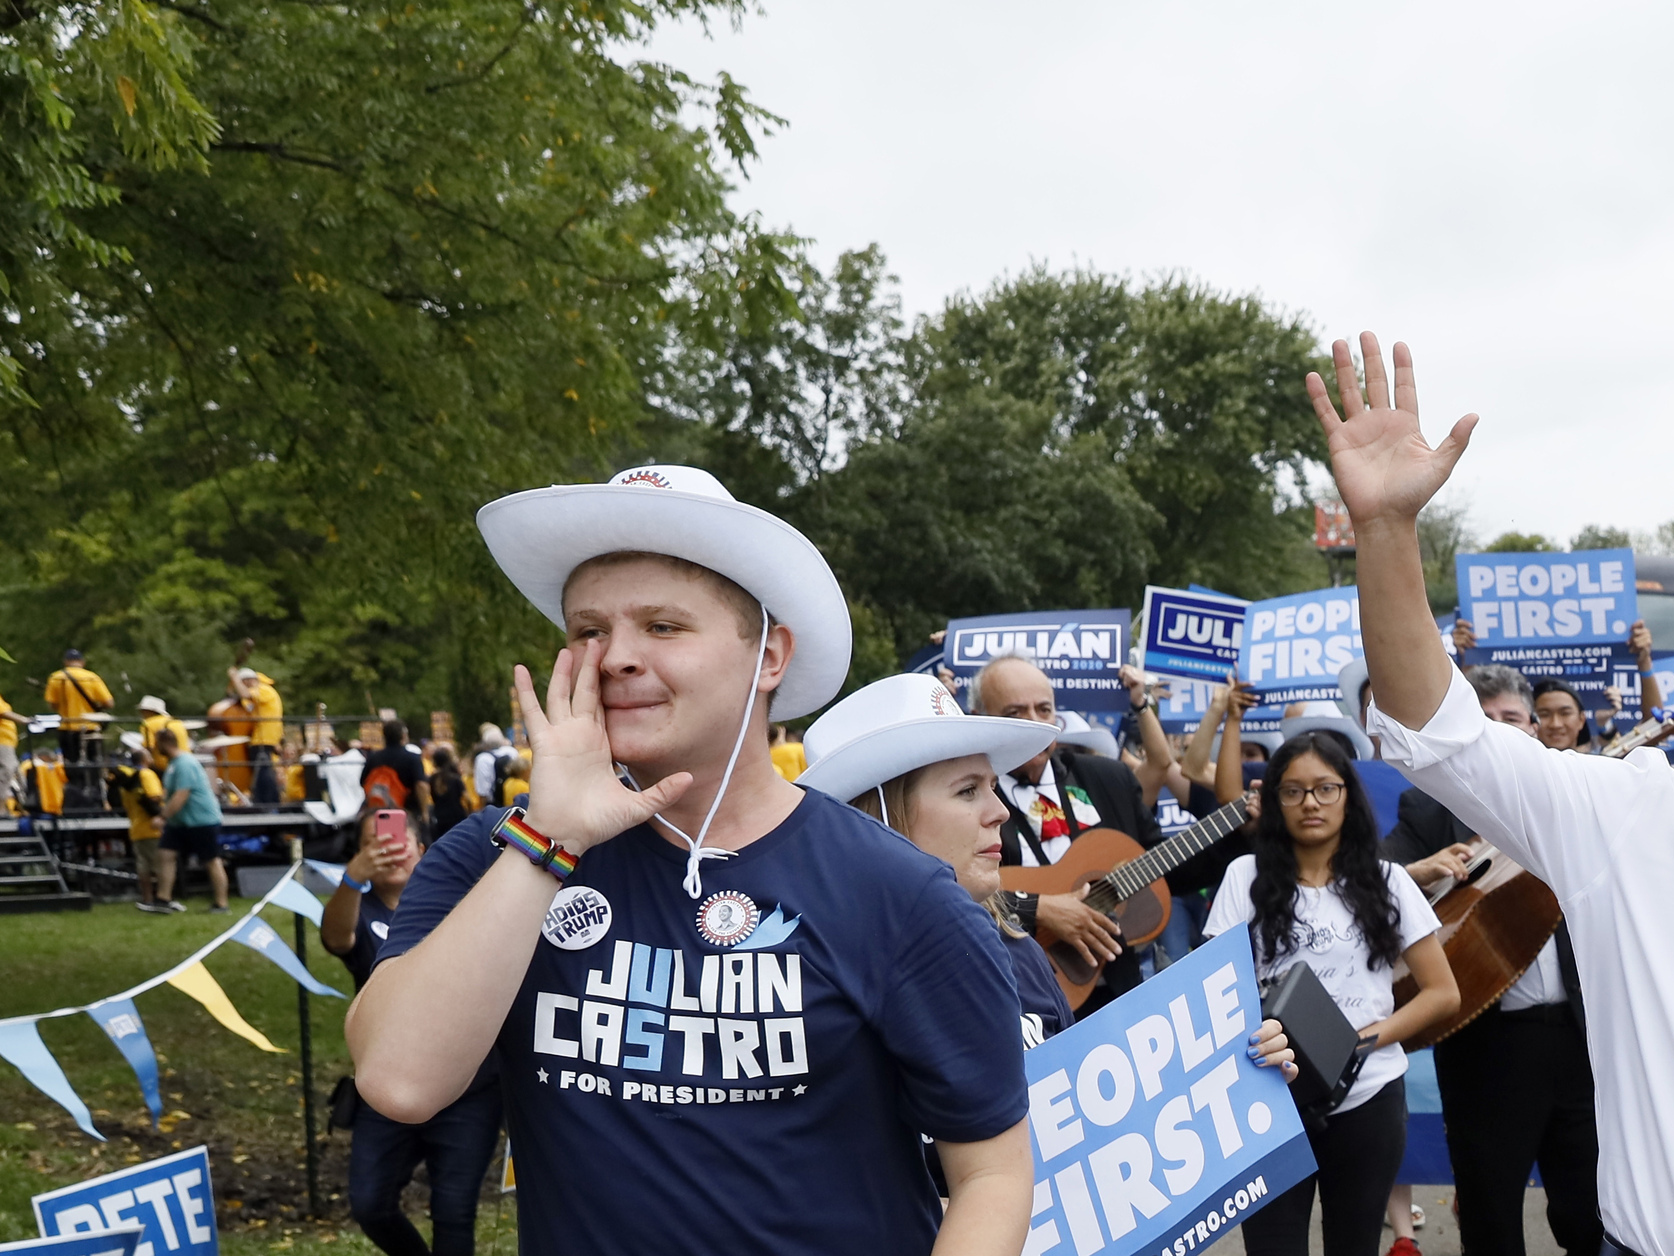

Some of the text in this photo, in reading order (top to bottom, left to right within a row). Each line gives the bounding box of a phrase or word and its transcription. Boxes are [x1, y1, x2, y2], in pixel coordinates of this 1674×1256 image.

[1468, 561, 1624, 598] PEOPLE
[1473, 597, 1626, 640] FIRST.
[964, 623, 1111, 659] JULIÁN
[1066, 678, 1122, 689] DESTINY.
[1072, 660, 1103, 670] 2020
[548, 906, 608, 943] TRUMP
[534, 992, 809, 1079] CASTRO
[1028, 961, 1246, 1163] EOPLE
[560, 1071, 784, 1104] FOR PRESIDENT
